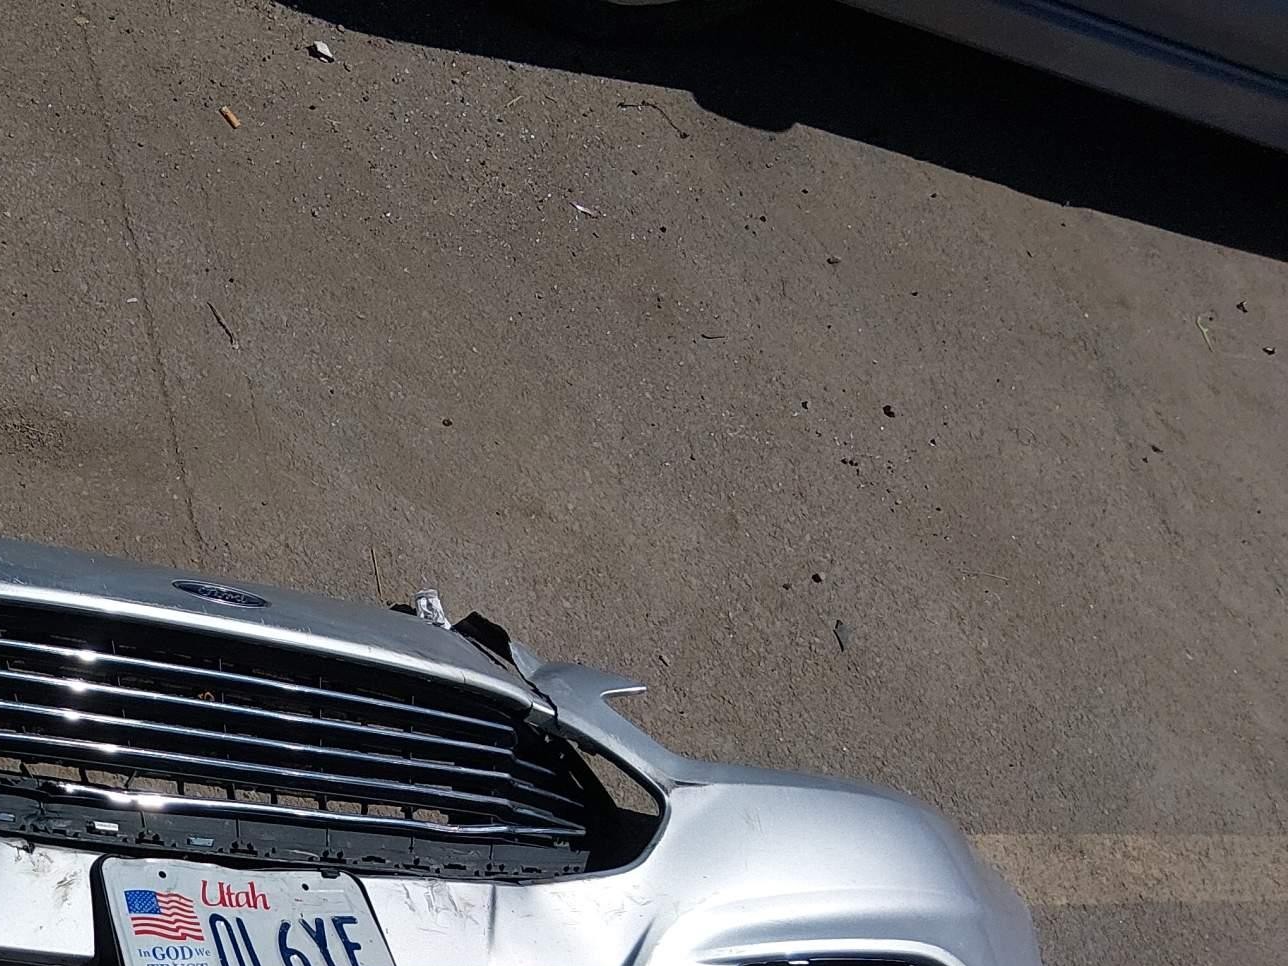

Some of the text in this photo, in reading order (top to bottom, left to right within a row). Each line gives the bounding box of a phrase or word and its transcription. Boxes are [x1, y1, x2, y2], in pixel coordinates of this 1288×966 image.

[198, 586, 248, 604] Ford
[201, 880, 270, 910] Utah
[139, 946, 211, 961] In GOD We
